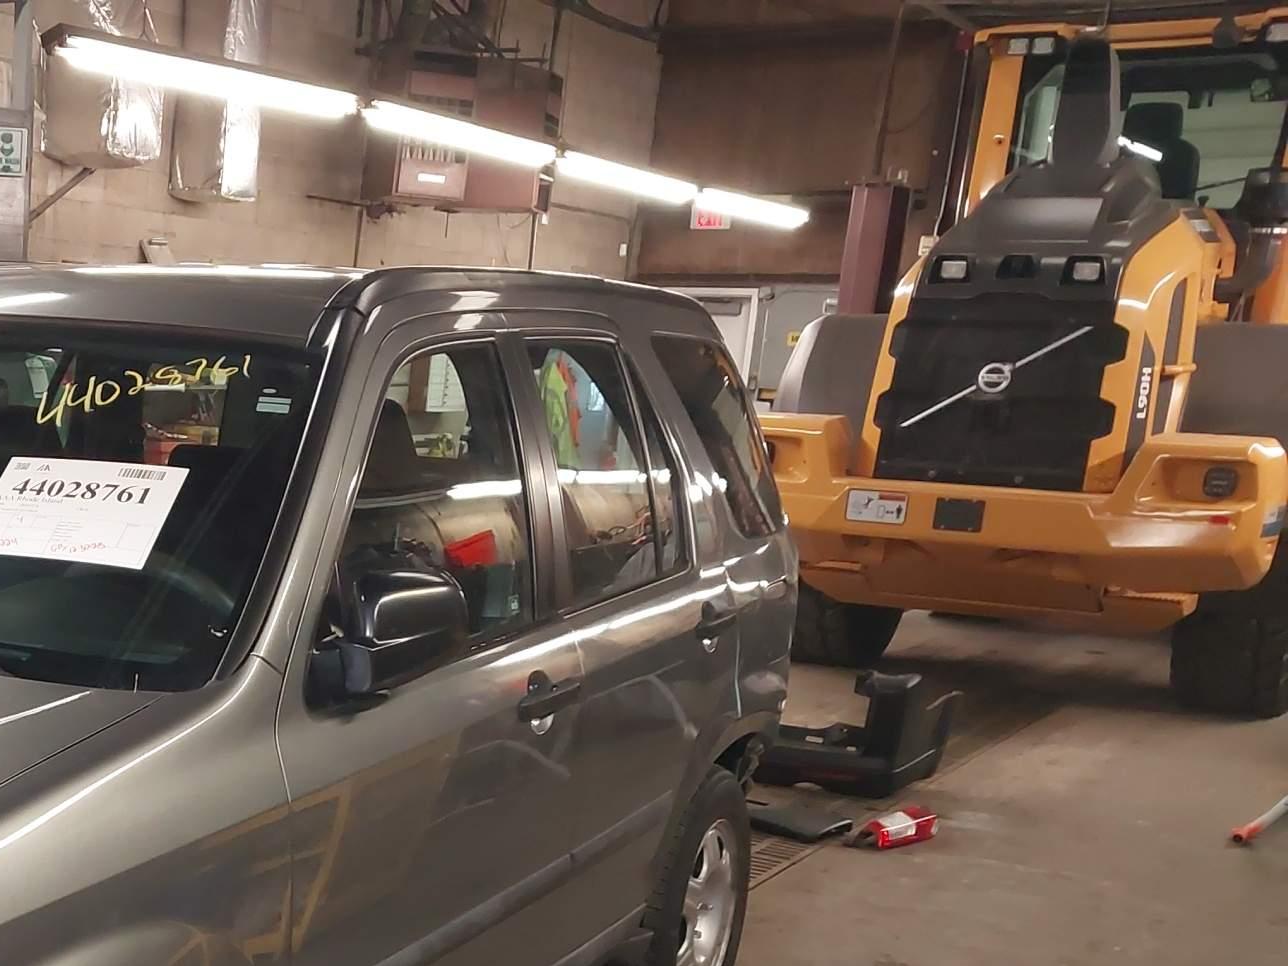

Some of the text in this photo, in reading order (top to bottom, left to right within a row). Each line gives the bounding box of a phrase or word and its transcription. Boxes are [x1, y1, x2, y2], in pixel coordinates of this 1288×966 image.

[36, 354, 251, 427] 44028761
[1136, 367, 1153, 419] L90H
[11, 478, 152, 505] 44028761
